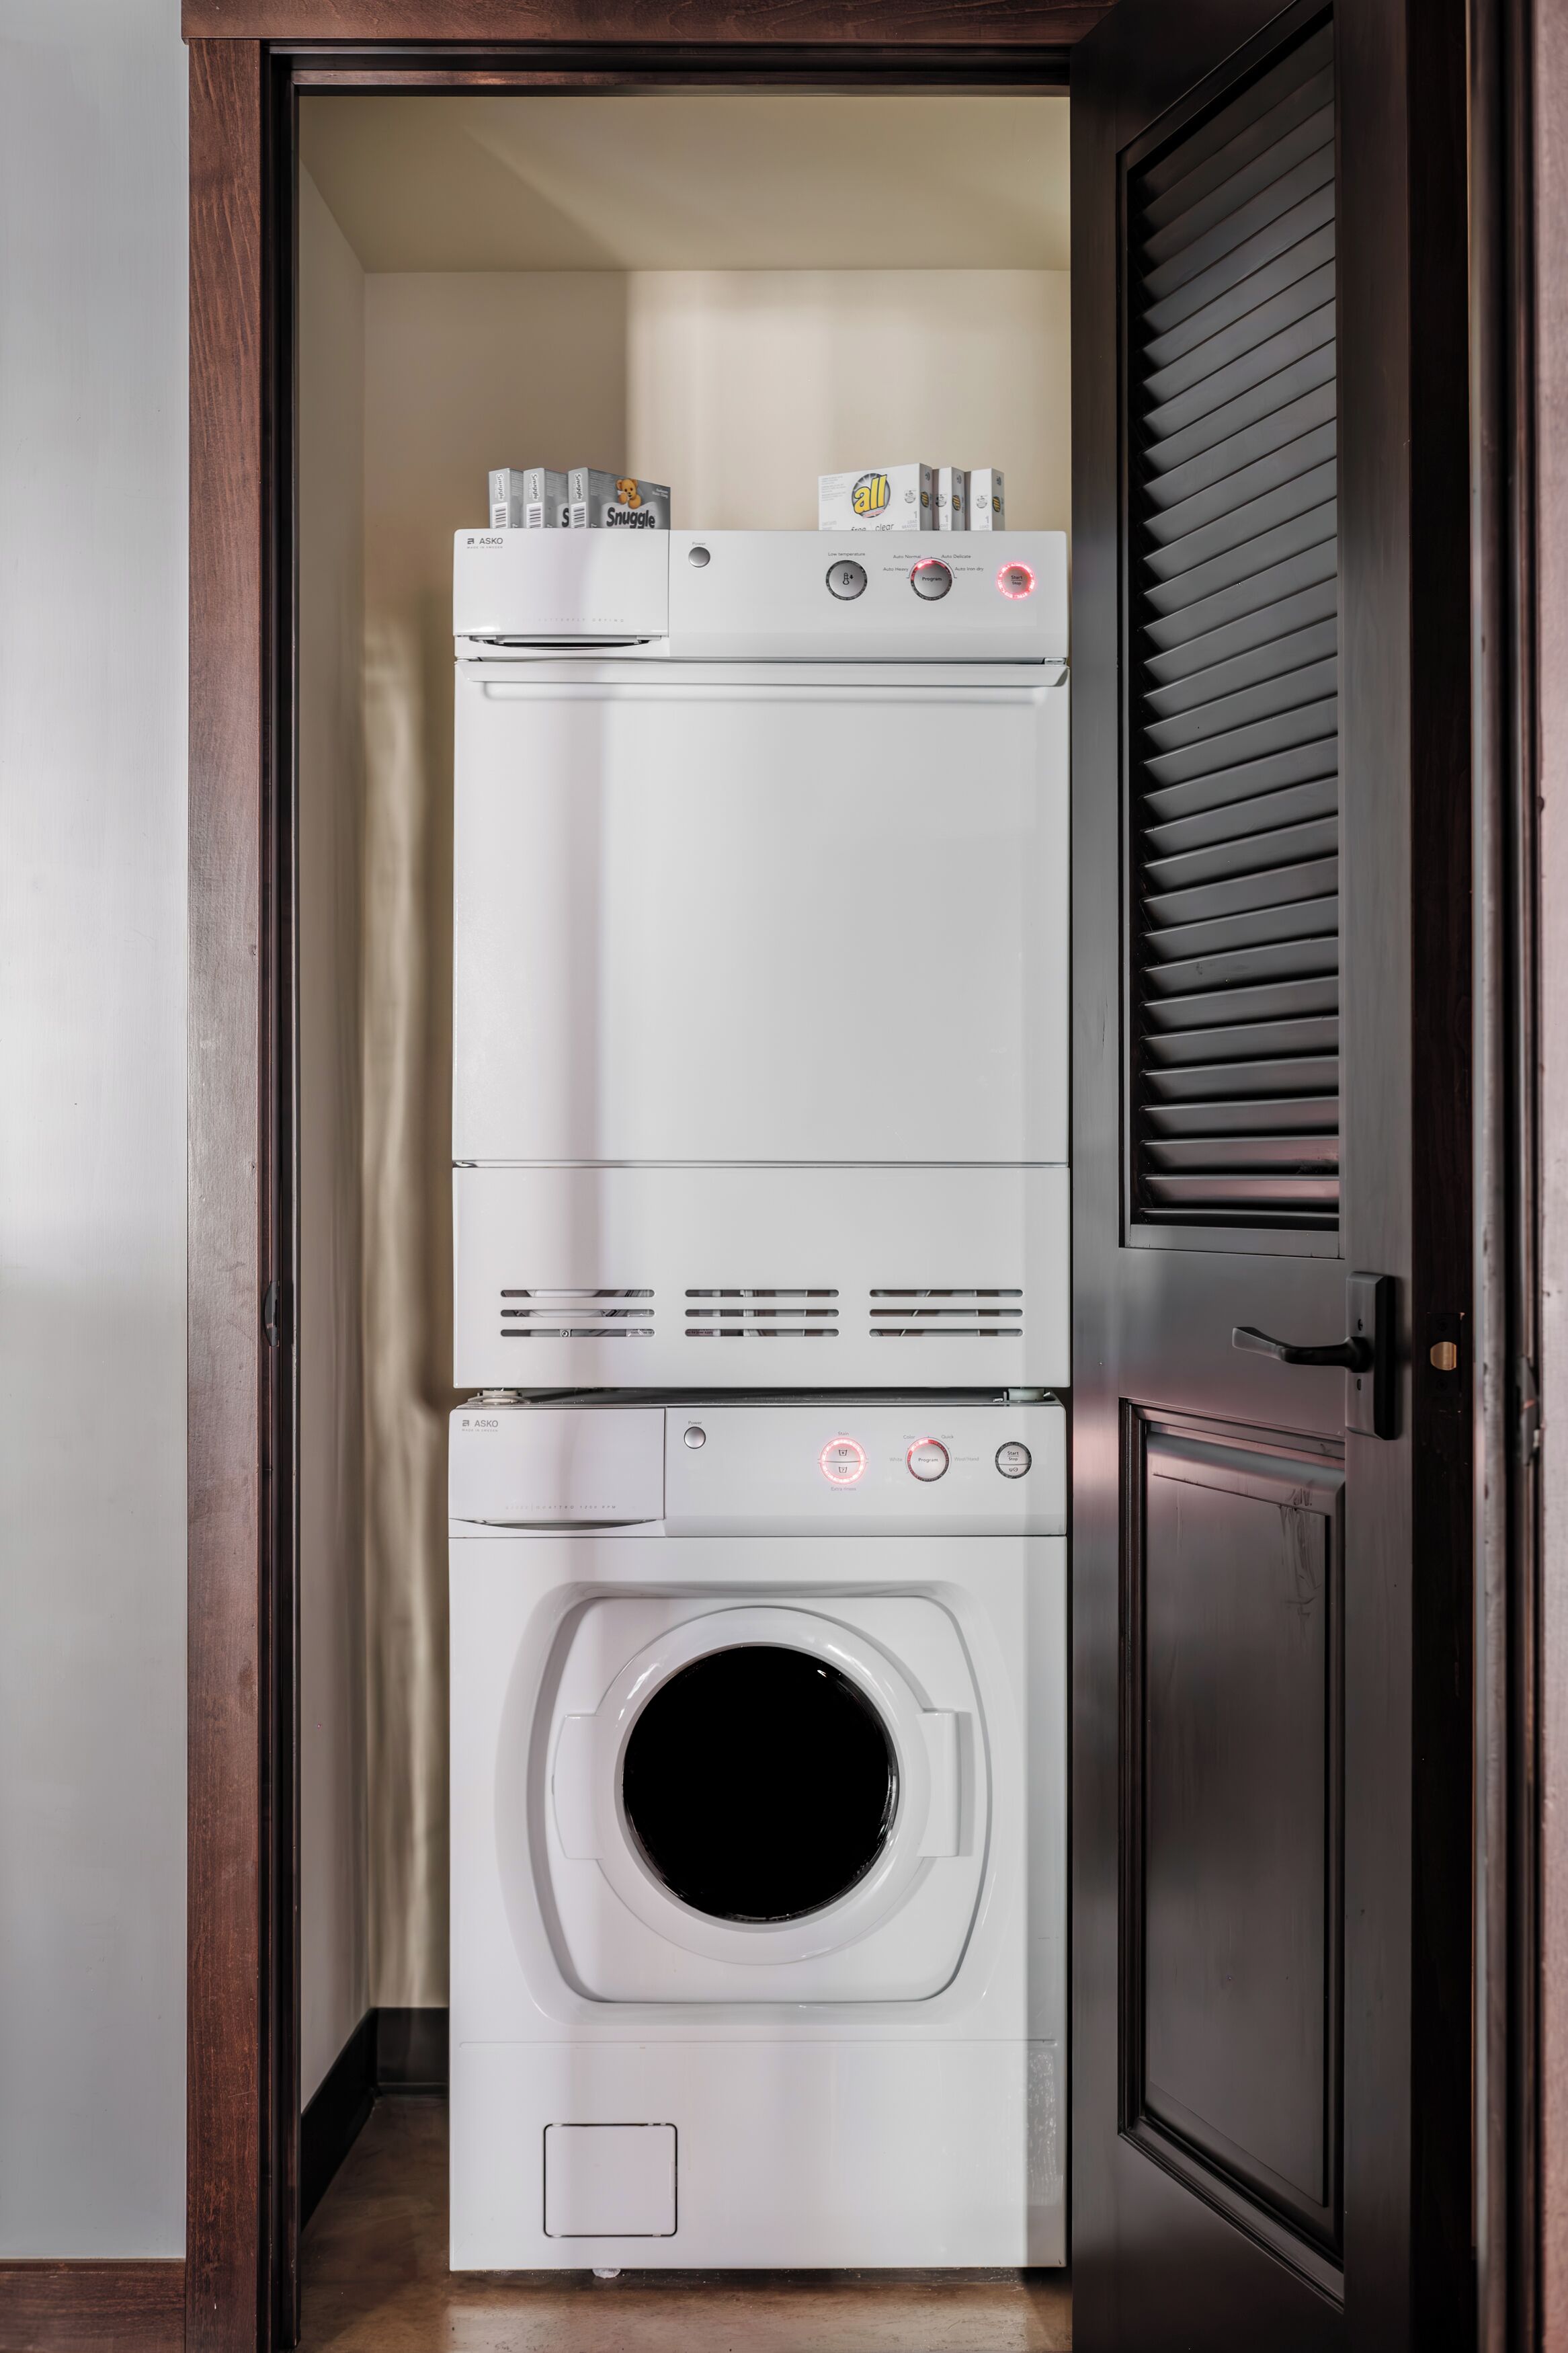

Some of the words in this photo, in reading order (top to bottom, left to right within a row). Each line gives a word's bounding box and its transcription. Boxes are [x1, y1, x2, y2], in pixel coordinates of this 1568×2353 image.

[497, 474, 505, 500] Snuggle
[531, 474, 539, 500] Snuggle
[575, 474, 583, 500] Snuggle
[854, 474, 888, 514] all
[606, 507, 655, 528] Snuggle
[985, 516, 989, 524] 1
